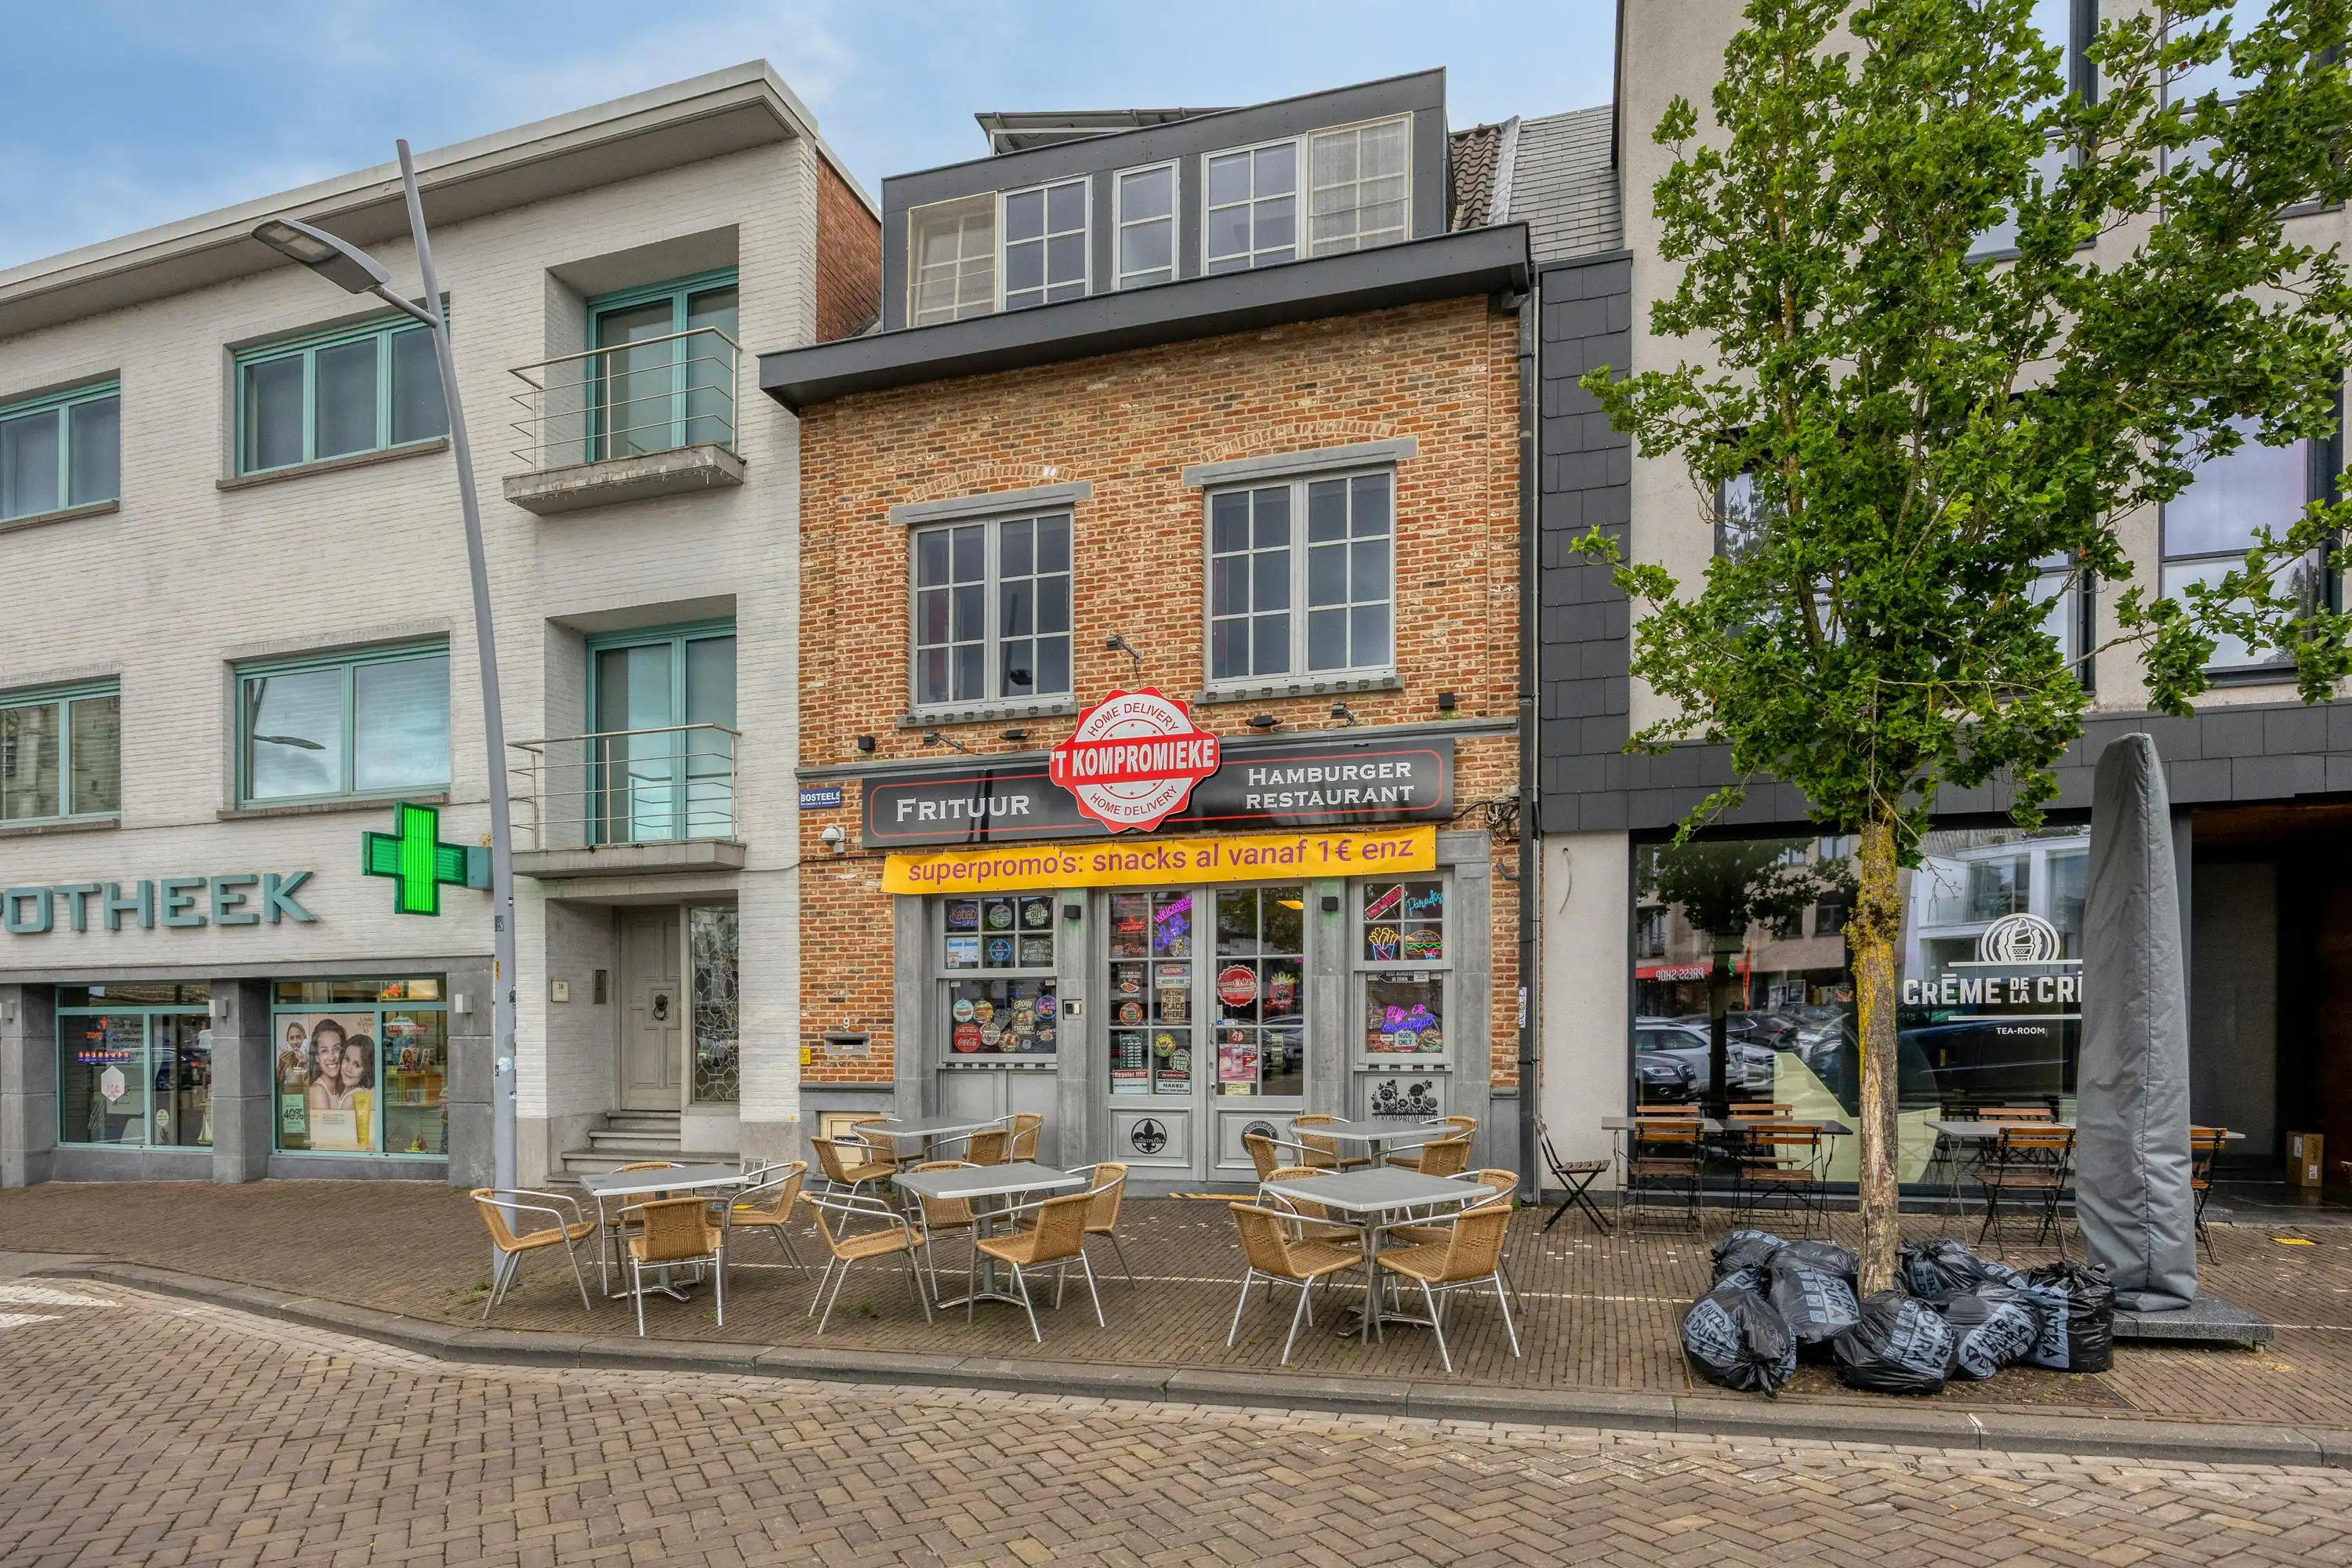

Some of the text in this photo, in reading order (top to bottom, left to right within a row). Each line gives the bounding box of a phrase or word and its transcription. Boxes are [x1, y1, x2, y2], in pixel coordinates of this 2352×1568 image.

[1087, 702, 1179, 737] HOME DELIVERY
[1051, 739, 1215, 778] 'T KOMPROMIEKE
[1248, 762, 1411, 786] HAMBURGER
[800, 792, 840, 802] BOSTEELS
[897, 795, 1030, 822] FRITUUR
[1090, 786, 1178, 815] HOME DELIVERY
[1247, 785, 1414, 809] RESTAURANT
[908, 850, 1083, 884] superpromo's:
[1093, 846, 1186, 872] snacks
[1196, 844, 1219, 868] al
[1229, 839, 1308, 866] vanaf
[1362, 839, 1414, 861] enz
[0, 871, 315, 934] OTHEEK
[1406, 889, 1443, 917] Paradis
[557, 982, 564, 991] 10
[2010, 977, 2029, 989] DE
[1014, 1000, 1033, 1010] GROUP
[2010, 991, 2030, 1004] LA
[844, 1018, 850, 1029] 9
